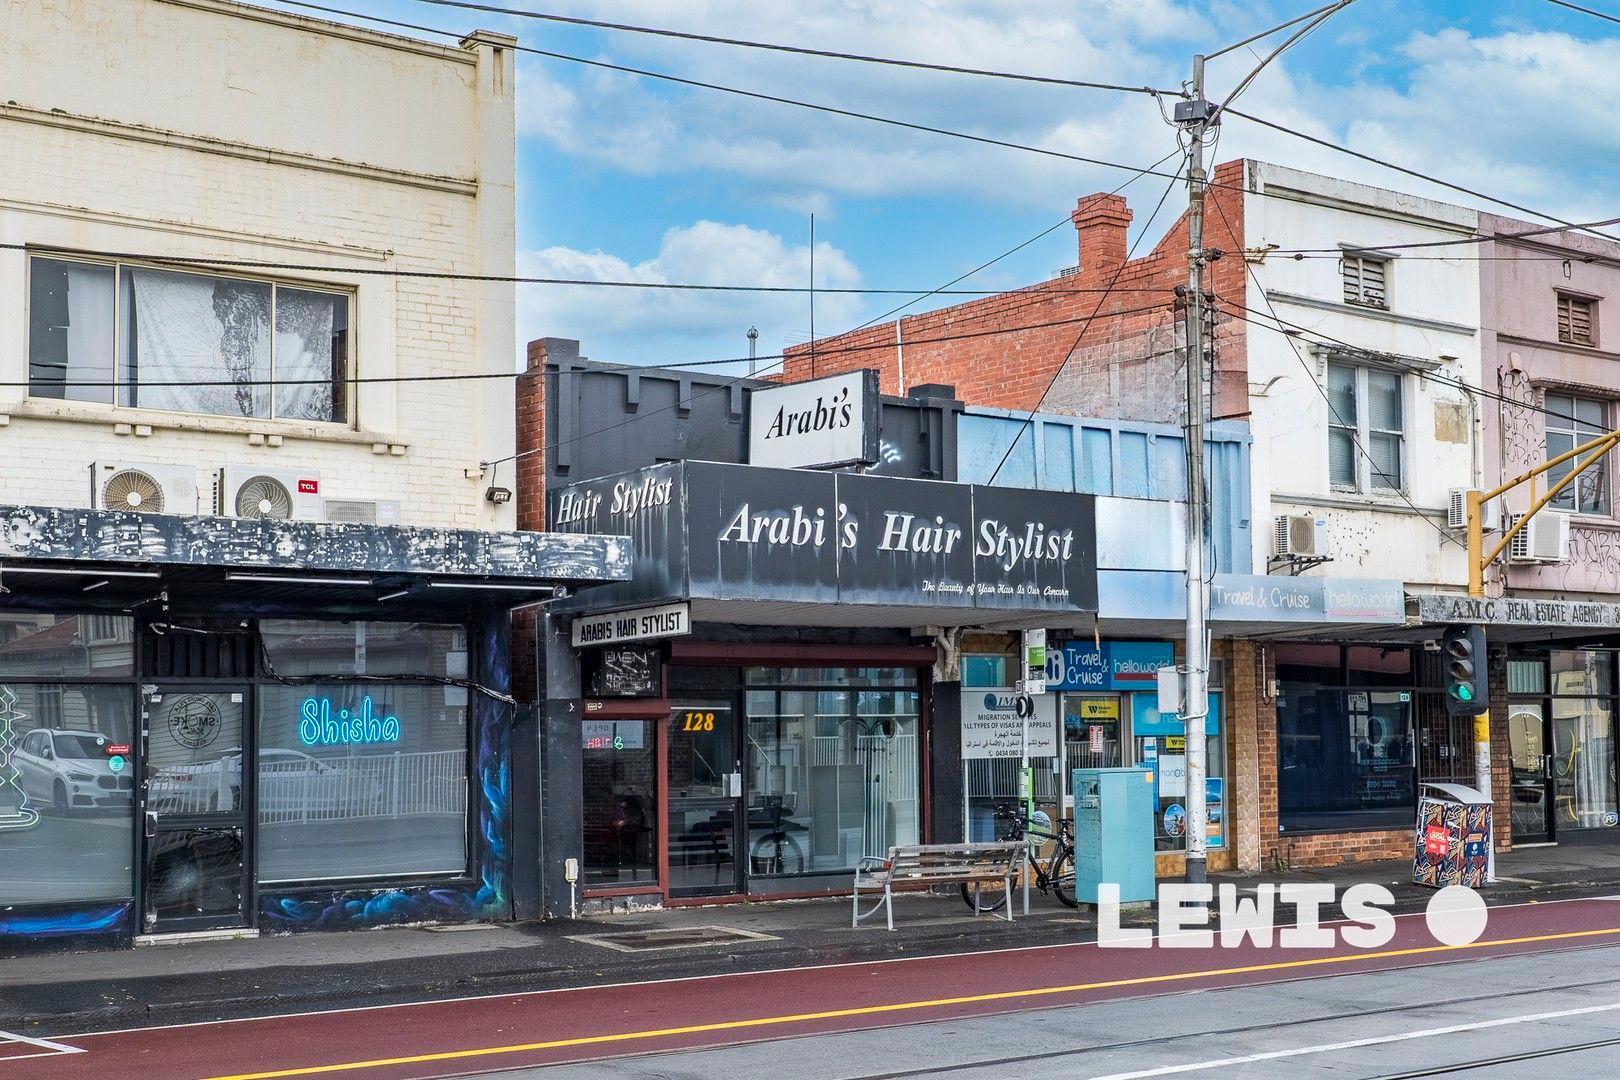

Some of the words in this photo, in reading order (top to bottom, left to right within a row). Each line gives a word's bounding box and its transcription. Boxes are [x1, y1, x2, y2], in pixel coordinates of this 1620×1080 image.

[764, 387, 853, 440] Arabi's
[557, 489, 602, 525] Hair
[610, 477, 673, 519] Stylist
[719, 502, 859, 550] Arabi's
[877, 510, 961, 554] Hair
[976, 518, 1074, 572] Stylist
[1213, 585, 1254, 606] Travel
[1256, 587, 1267, 609] &
[1271, 587, 1310, 609] Cruise
[616, 617, 637, 638] HAIR
[641, 611, 682, 634] STYLIST
[1508, 602, 1532, 621] REAL
[1535, 603, 1567, 622] ESTATE
[1572, 605, 1602, 624] AGENCY
[1067, 648, 1102, 667] Travel
[1101, 659, 1110, 673] &
[1067, 666, 1103, 686] Cruise
[301, 695, 399, 745] Shisha
[682, 713, 715, 731] 128
